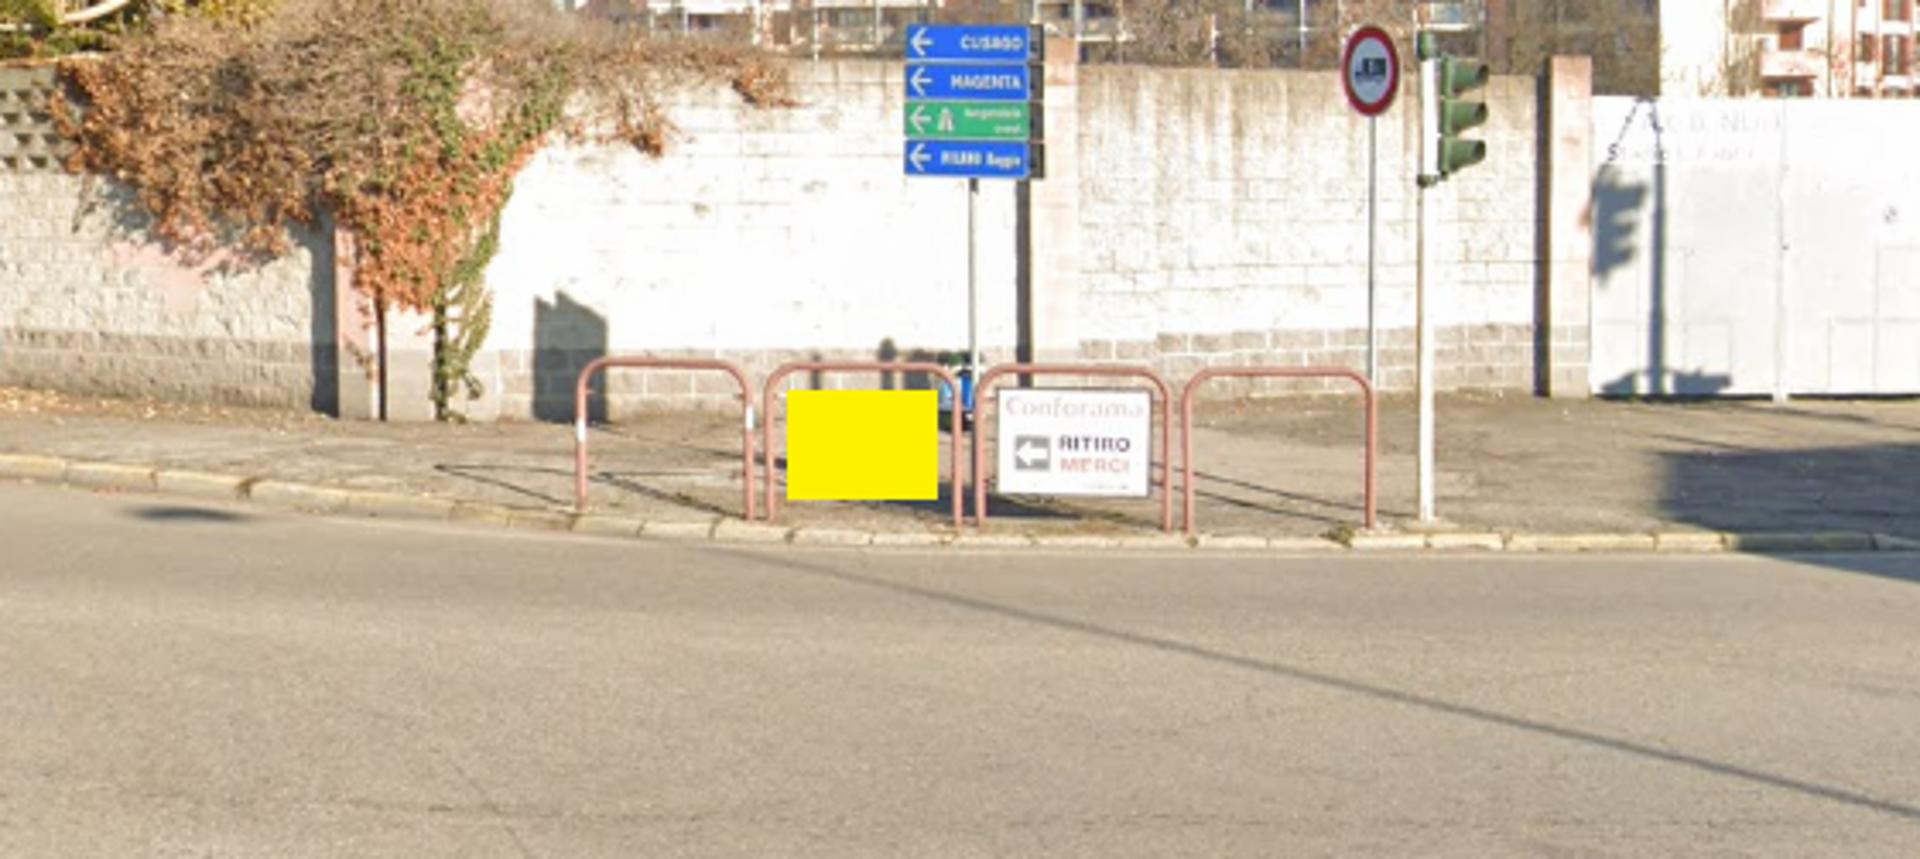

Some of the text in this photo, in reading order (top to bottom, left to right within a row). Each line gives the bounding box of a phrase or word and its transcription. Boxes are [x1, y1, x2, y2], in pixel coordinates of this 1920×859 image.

[960, 34, 1023, 51] CUSAGO
[950, 74, 1021, 91] MAGENTA
[941, 149, 1021, 169] MILANO Baggio
[1006, 395, 1143, 418] Conforama
[1058, 435, 1131, 452] RITIRO
[1059, 457, 1130, 473] MERCI
